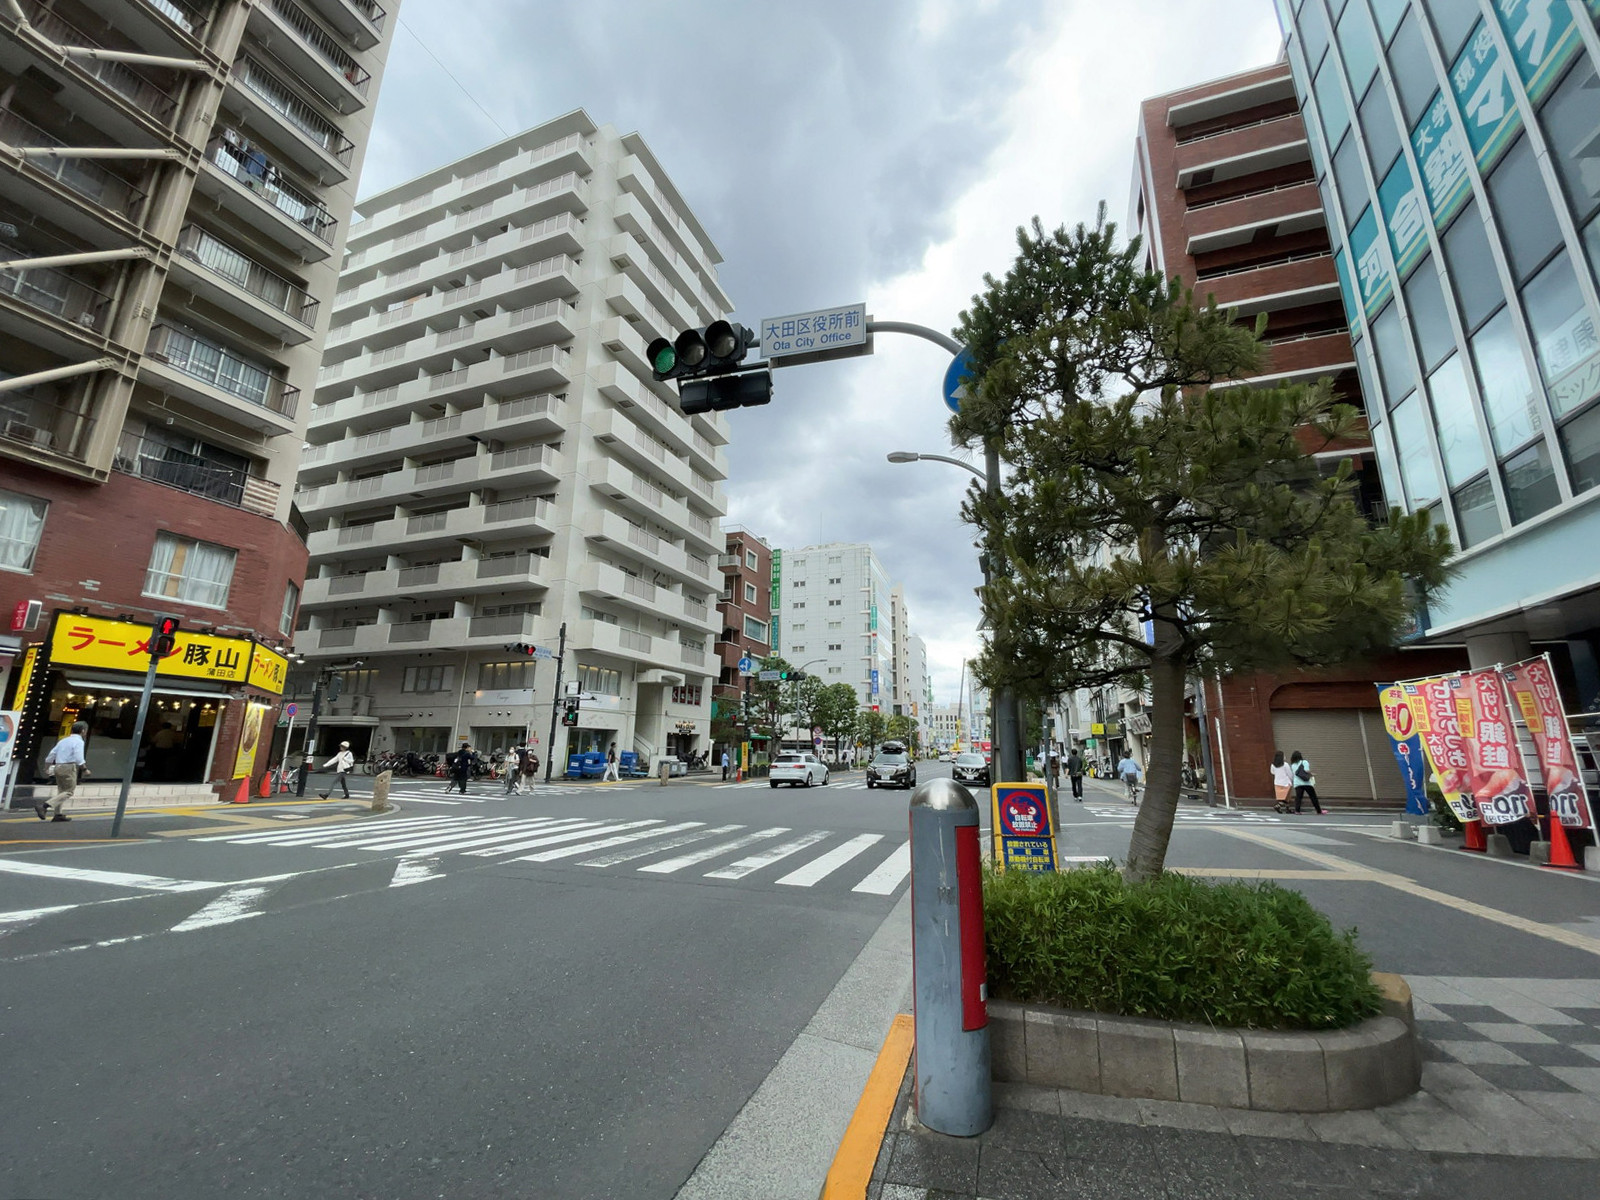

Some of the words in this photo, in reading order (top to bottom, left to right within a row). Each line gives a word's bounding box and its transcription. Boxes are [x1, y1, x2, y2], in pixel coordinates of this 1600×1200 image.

[765, 311, 860, 340] 大田区役所前
[773, 341, 791, 351] Ota
[795, 337, 815, 348] City
[820, 332, 852, 343] Office
